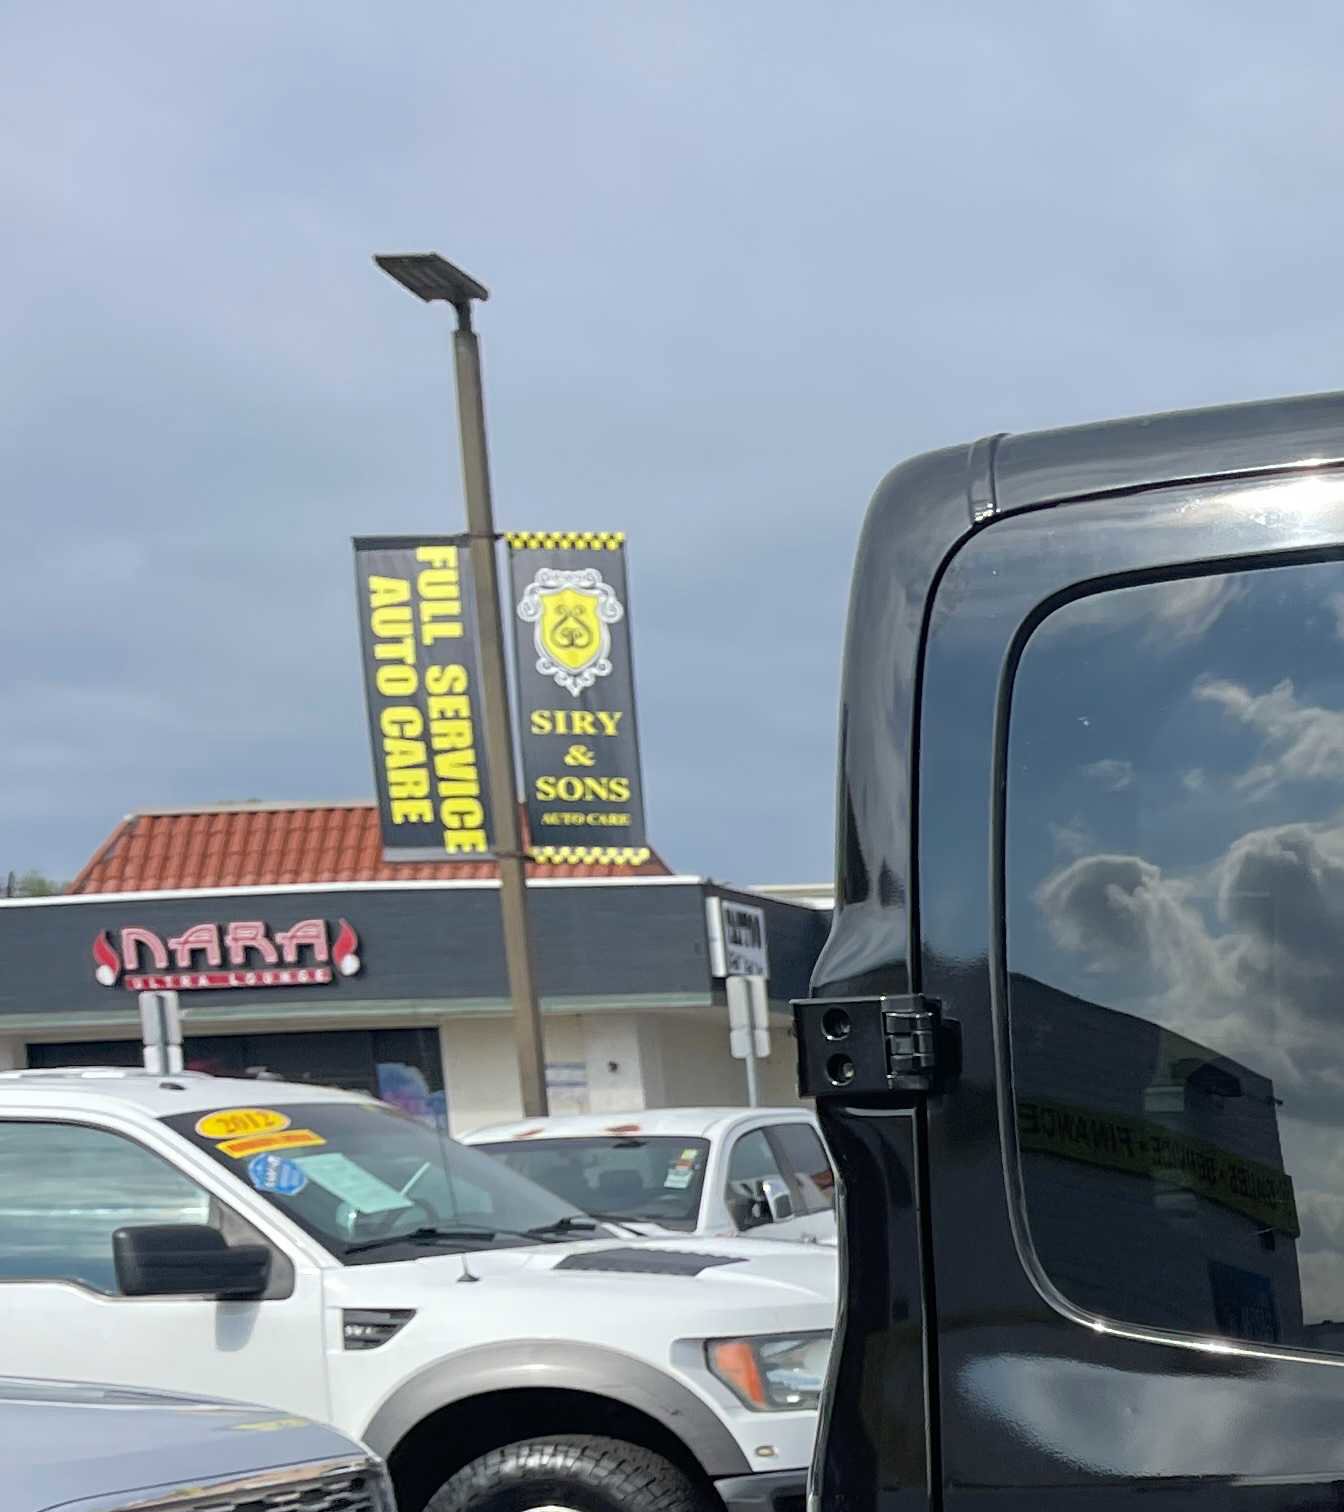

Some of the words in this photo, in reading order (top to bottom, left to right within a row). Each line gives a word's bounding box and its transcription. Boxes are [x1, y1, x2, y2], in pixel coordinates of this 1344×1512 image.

[416, 546, 463, 646] FULL
[368, 575, 418, 696] AUTO
[425, 665, 488, 854] SERVICE
[531, 710, 623, 737] SIRY
[564, 745, 595, 766] &
[380, 707, 434, 824] CARE
[536, 777, 631, 802] SONS
[121, 919, 329, 970] NARA
